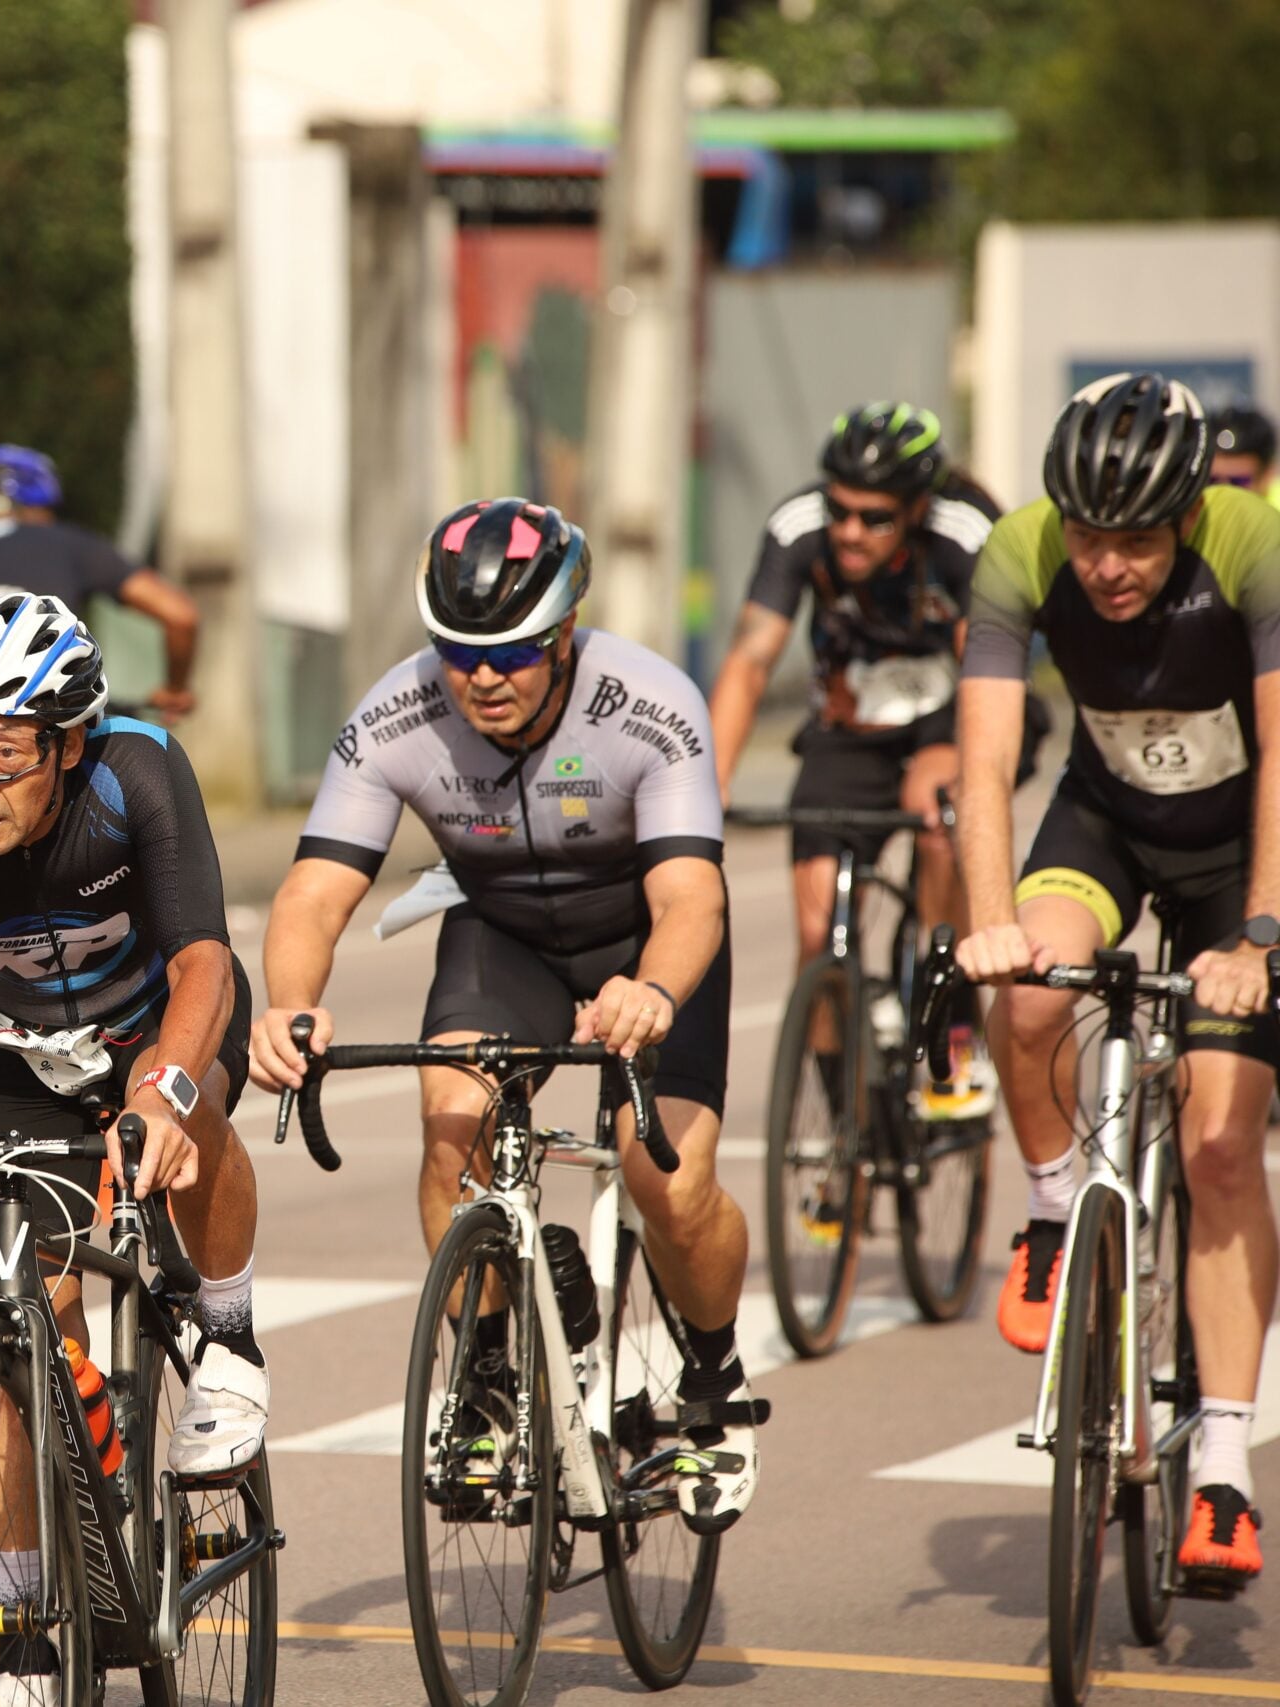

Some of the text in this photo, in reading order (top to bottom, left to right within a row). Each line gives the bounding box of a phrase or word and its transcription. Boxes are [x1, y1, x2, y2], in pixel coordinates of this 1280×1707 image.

[361, 680, 442, 727] BALMAM
[631, 699, 703, 758] BALMAM
[1142, 741, 1187, 769] 63
[78, 866, 131, 897] woom
